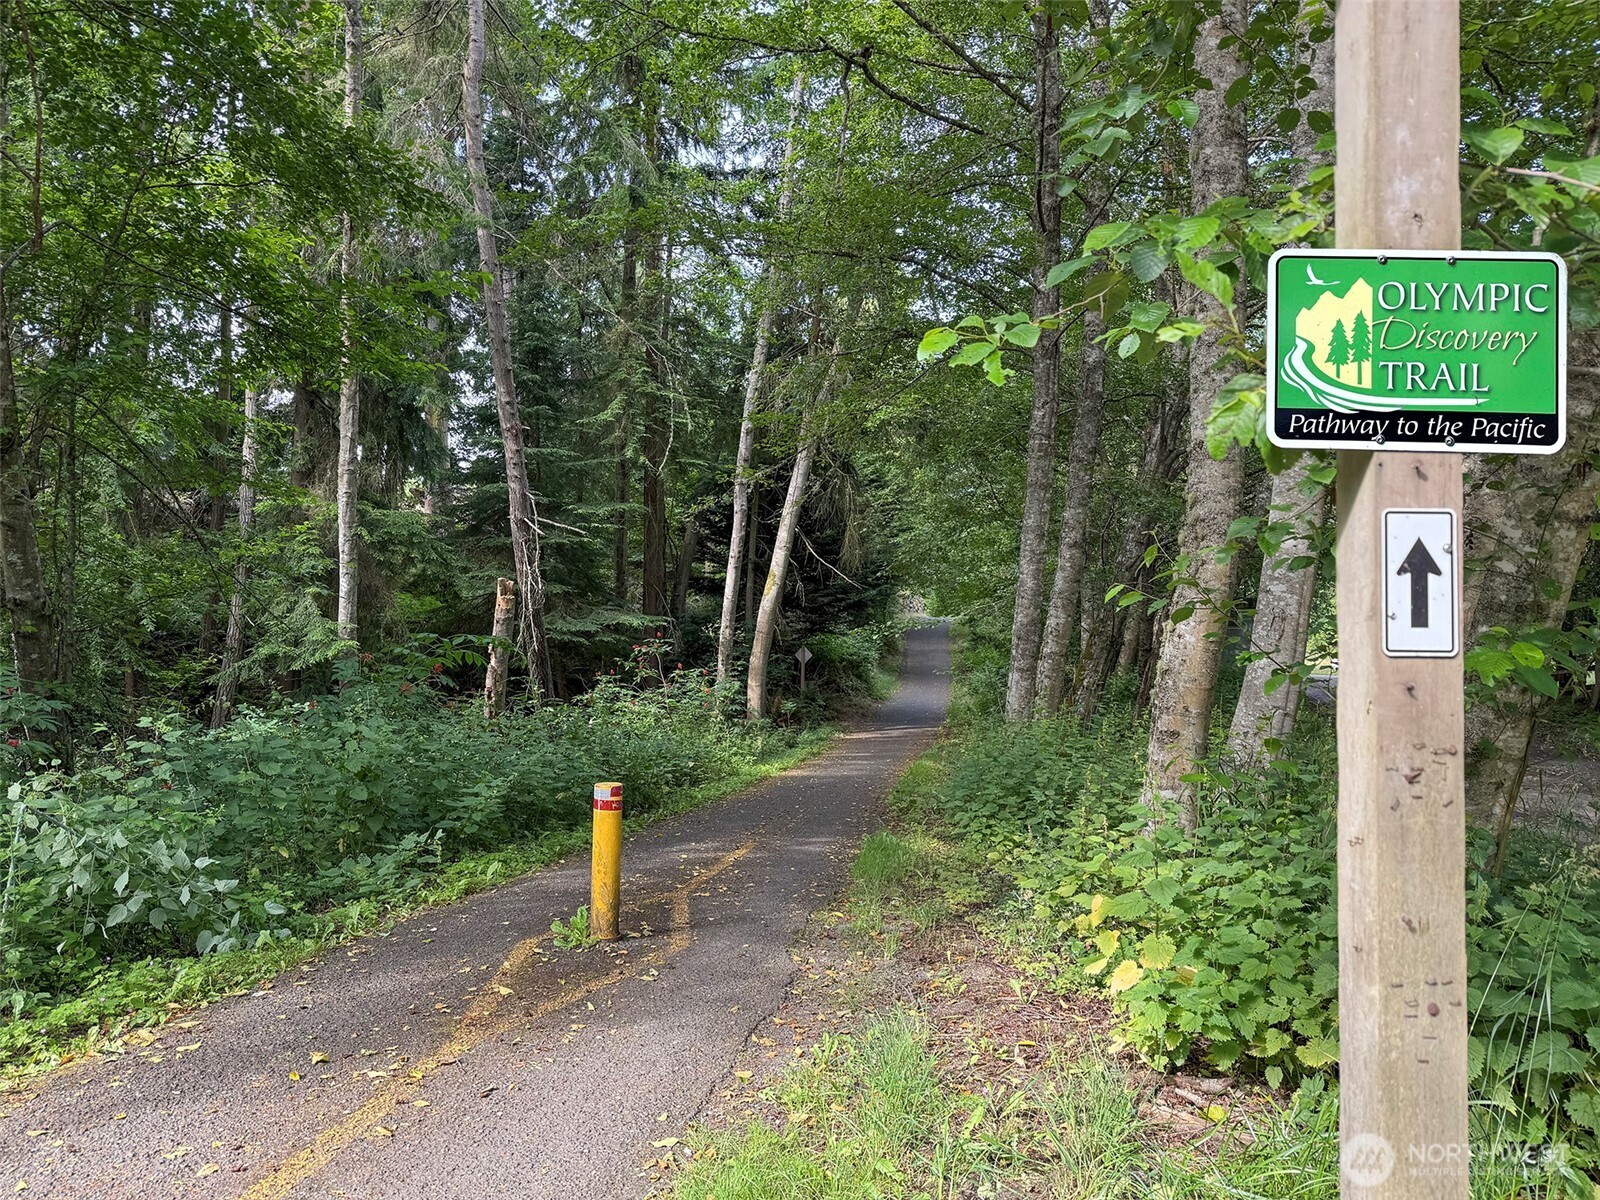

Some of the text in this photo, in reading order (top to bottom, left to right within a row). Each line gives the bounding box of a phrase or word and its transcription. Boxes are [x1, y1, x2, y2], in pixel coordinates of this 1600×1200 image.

[1377, 281, 1549, 313] OLYMPIC
[1372, 315, 1538, 365] Discovery
[1379, 361, 1490, 393] TRAIL
[1288, 413, 1547, 444] Pathway to the Pacific
